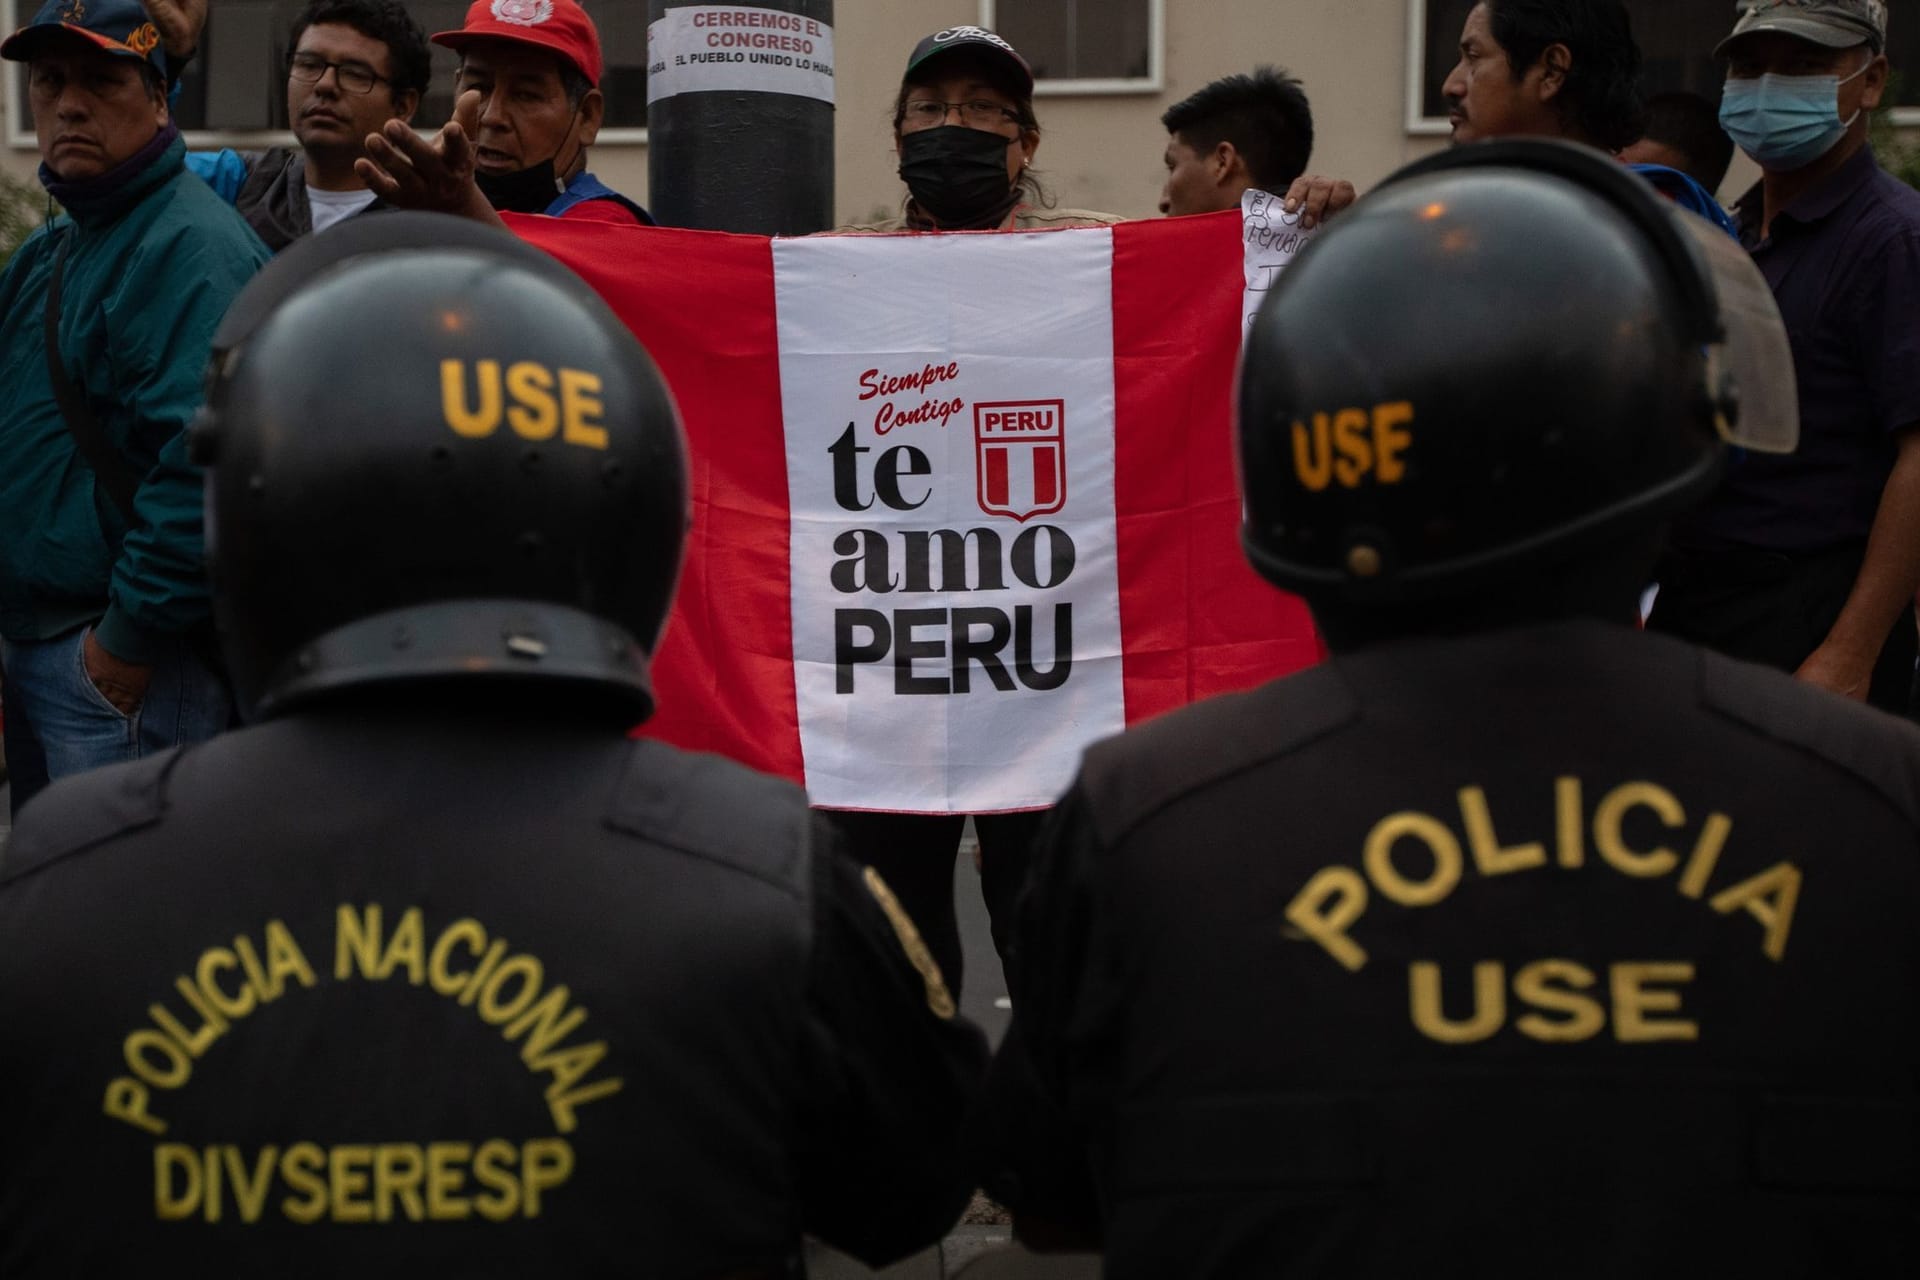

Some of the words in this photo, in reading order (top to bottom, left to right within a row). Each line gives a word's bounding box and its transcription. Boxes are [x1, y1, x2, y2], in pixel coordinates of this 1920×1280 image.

[675, 55, 687, 66] EL
[690, 52, 745, 65] PUEBLO
[749, 53, 793, 67] UNIDO
[796, 59, 810, 70] LO
[693, 12, 801, 33] CERREMOS
[806, 20, 823, 38] EL
[706, 32, 814, 55] CONGRESO
[439, 357, 610, 450] USE
[858, 361, 960, 401] Siempre
[874, 397, 965, 436] Contigo
[984, 410, 1054, 433] PERU
[827, 421, 933, 512] te
[1290, 400, 1415, 492] USE
[830, 524, 1076, 594] amo
[834, 602, 1073, 695] PERU
[1283, 776, 1803, 973] POLICIA
[103, 918, 318, 1135] POLICIA
[334, 902, 623, 1134] NACIONAL
[1408, 958, 1699, 1044] USE
[152, 1137, 574, 1223] DIVSERESP
